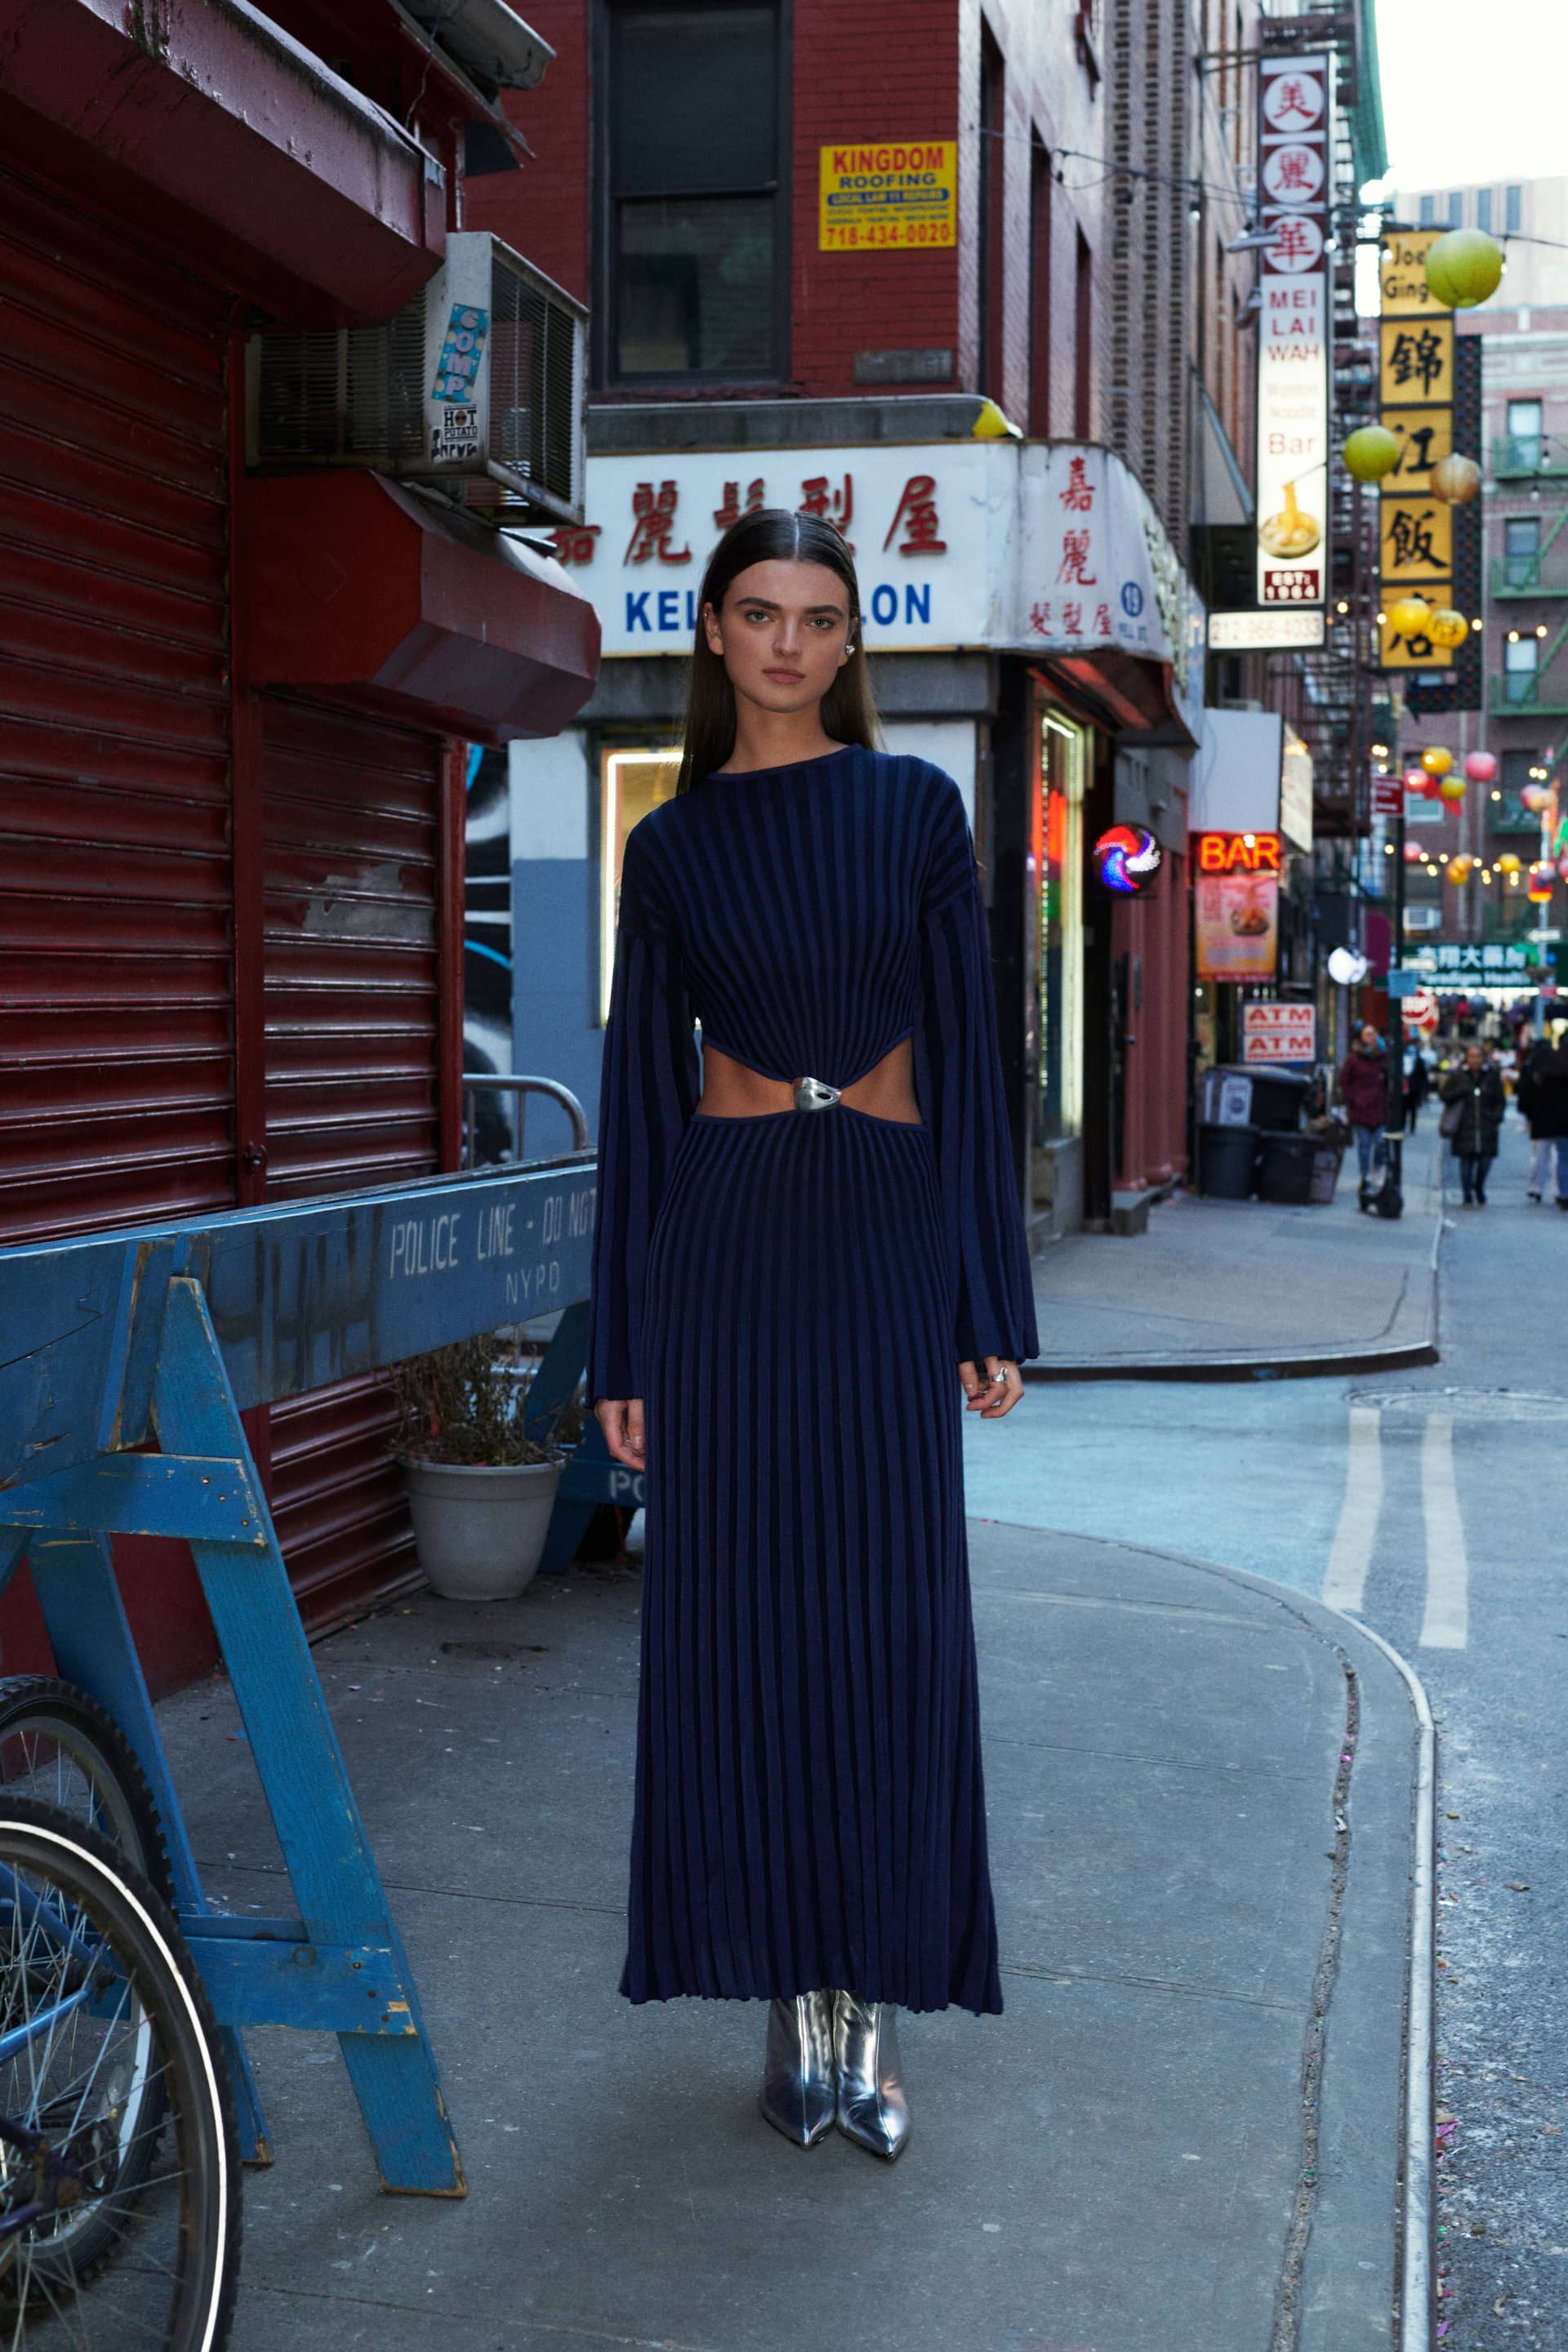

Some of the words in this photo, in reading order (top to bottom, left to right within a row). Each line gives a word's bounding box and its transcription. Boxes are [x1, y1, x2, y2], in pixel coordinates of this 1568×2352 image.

[833, 146, 945, 174] KINGDOM
[839, 172, 937, 189] ROOFING
[1272, 80, 1316, 267] 美麗華
[826, 223, 950, 244] 718-434-0020
[1269, 289, 1317, 309] MEI
[1272, 316, 1315, 336] LAI
[1267, 344, 1319, 362] WAH
[444, 426, 477, 437] POTATO
[1269, 432, 1318, 455] Bar
[1200, 835, 1281, 871] BAR
[1250, 1008, 1312, 1020] ATM
[1250, 1036, 1312, 1049] ATM
[390, 1213, 461, 1280] POLICE
[477, 1203, 516, 1260] LINE
[541, 1196, 563, 1245] DO
[506, 1261, 560, 1304] NYPD
